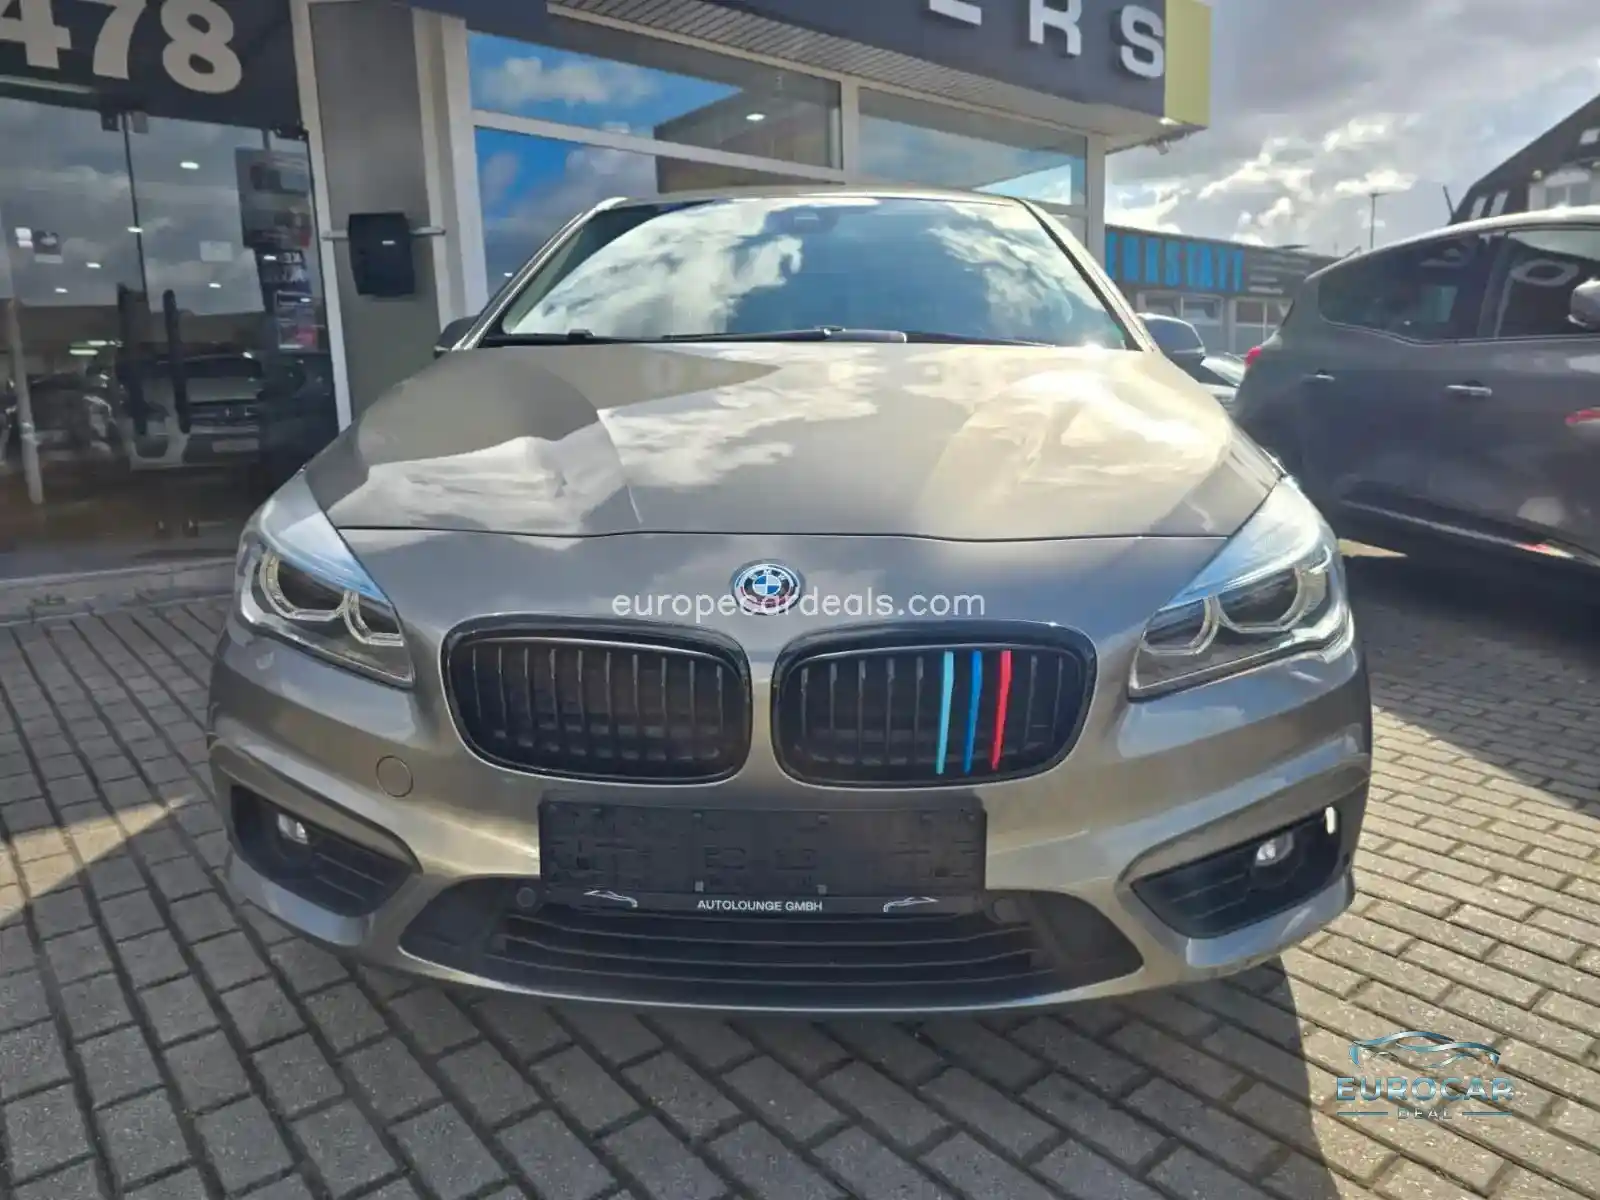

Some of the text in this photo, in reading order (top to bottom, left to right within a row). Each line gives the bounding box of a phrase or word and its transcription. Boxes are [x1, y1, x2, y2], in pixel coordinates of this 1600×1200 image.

[0, 0, 242, 94] 478
[929, 0, 1164, 78] RS
[697, 899, 823, 912] AUTOLOUNGE GMBH
